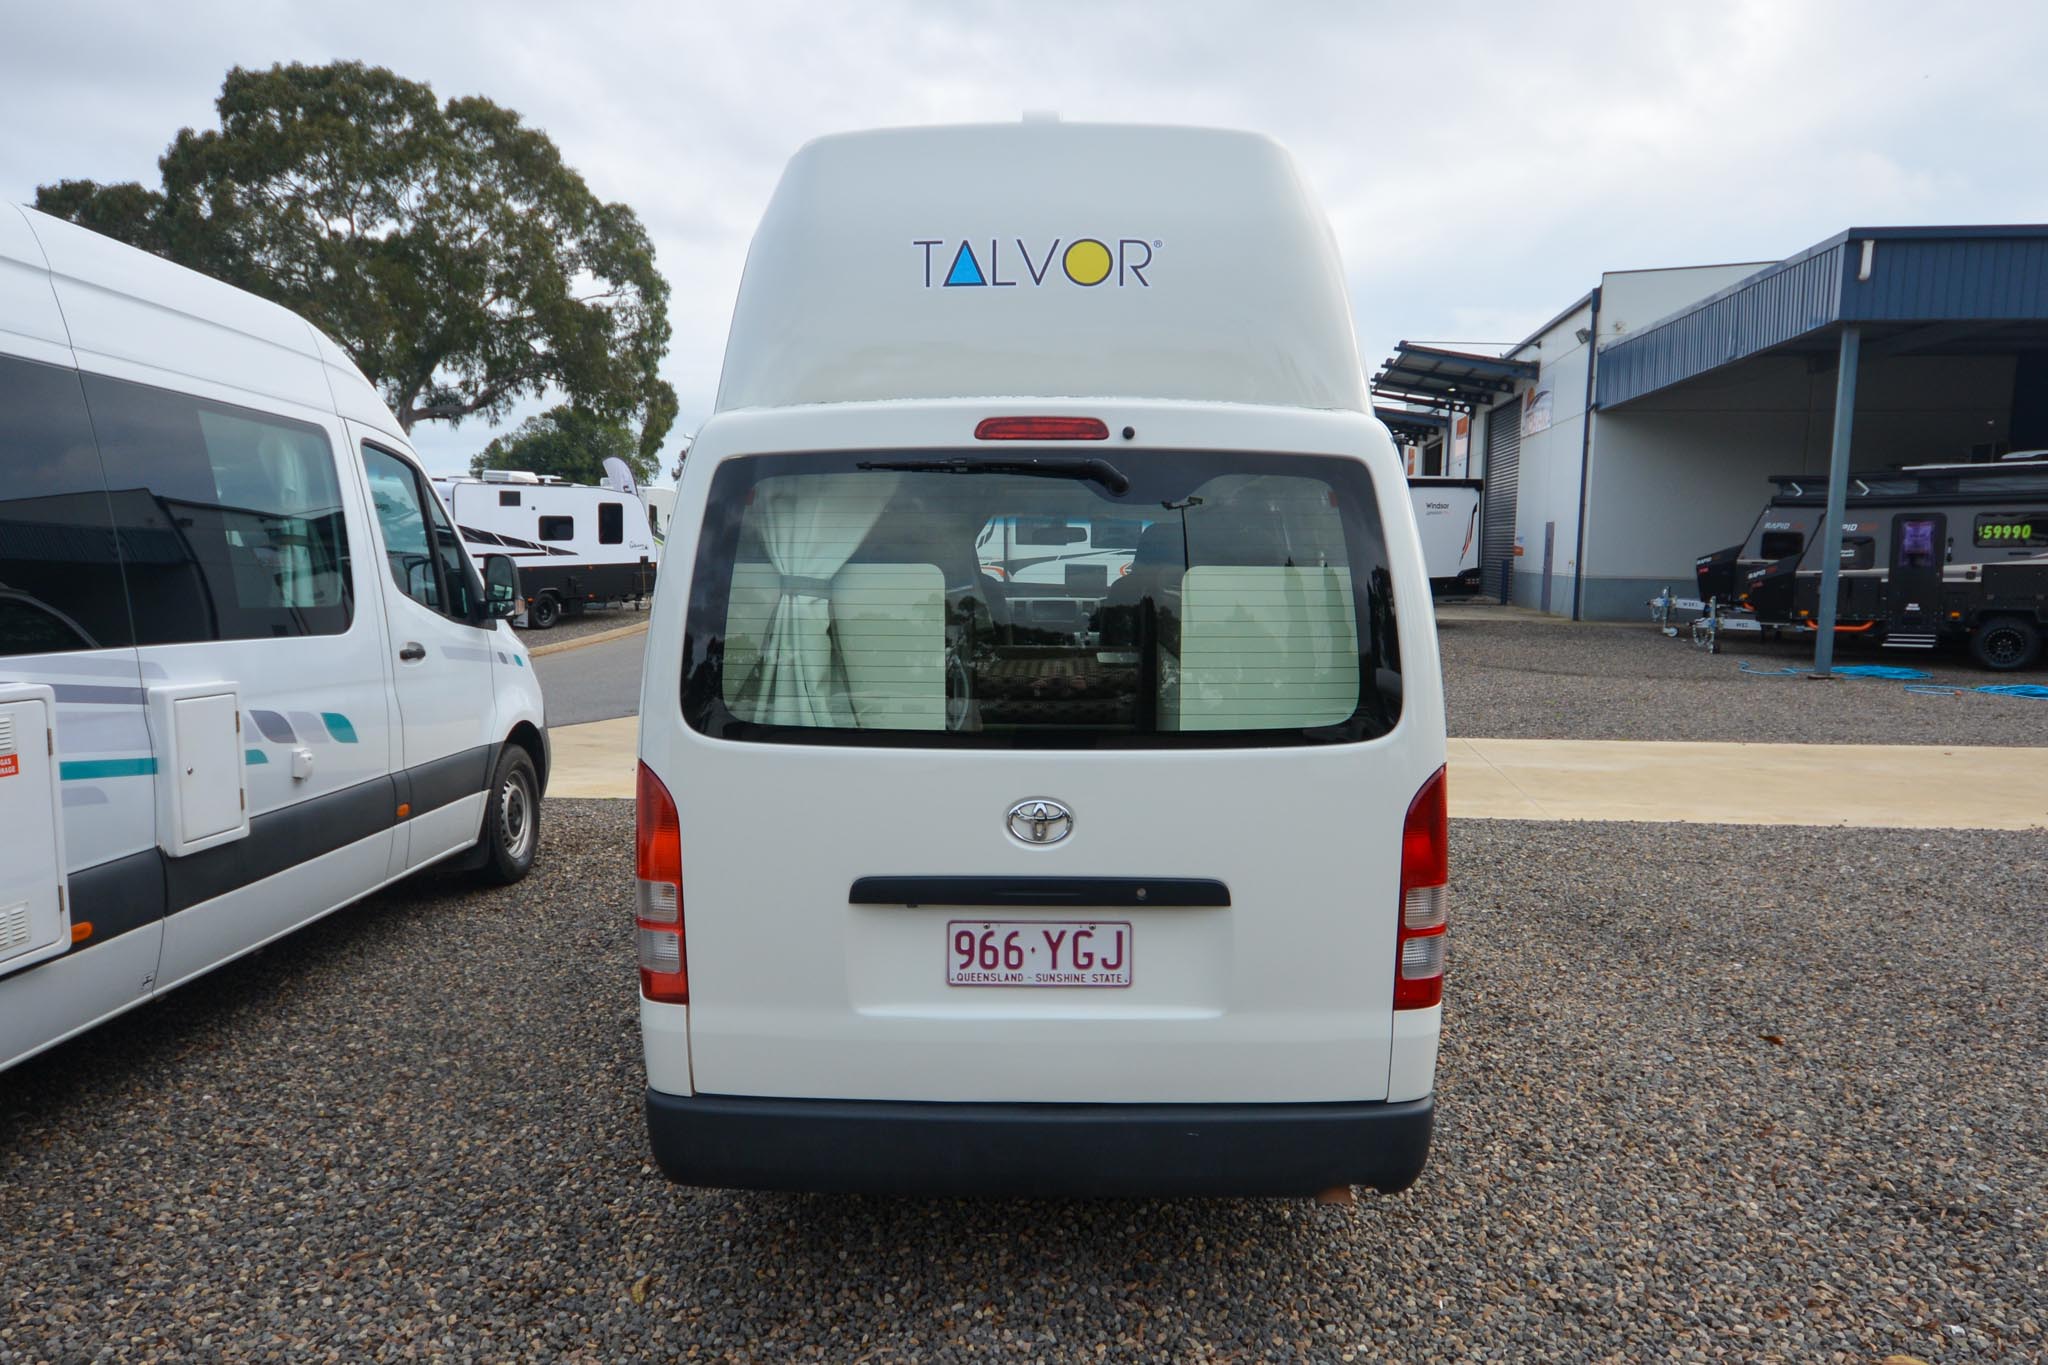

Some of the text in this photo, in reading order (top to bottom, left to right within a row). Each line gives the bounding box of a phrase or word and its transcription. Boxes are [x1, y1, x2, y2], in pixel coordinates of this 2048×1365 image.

[1425, 502, 1450, 510] Windsor
[957, 973, 1024, 982] QUEENSLAND
[1035, 973, 1087, 983] SUNSHINE
[1092, 974, 1122, 983] STATE
